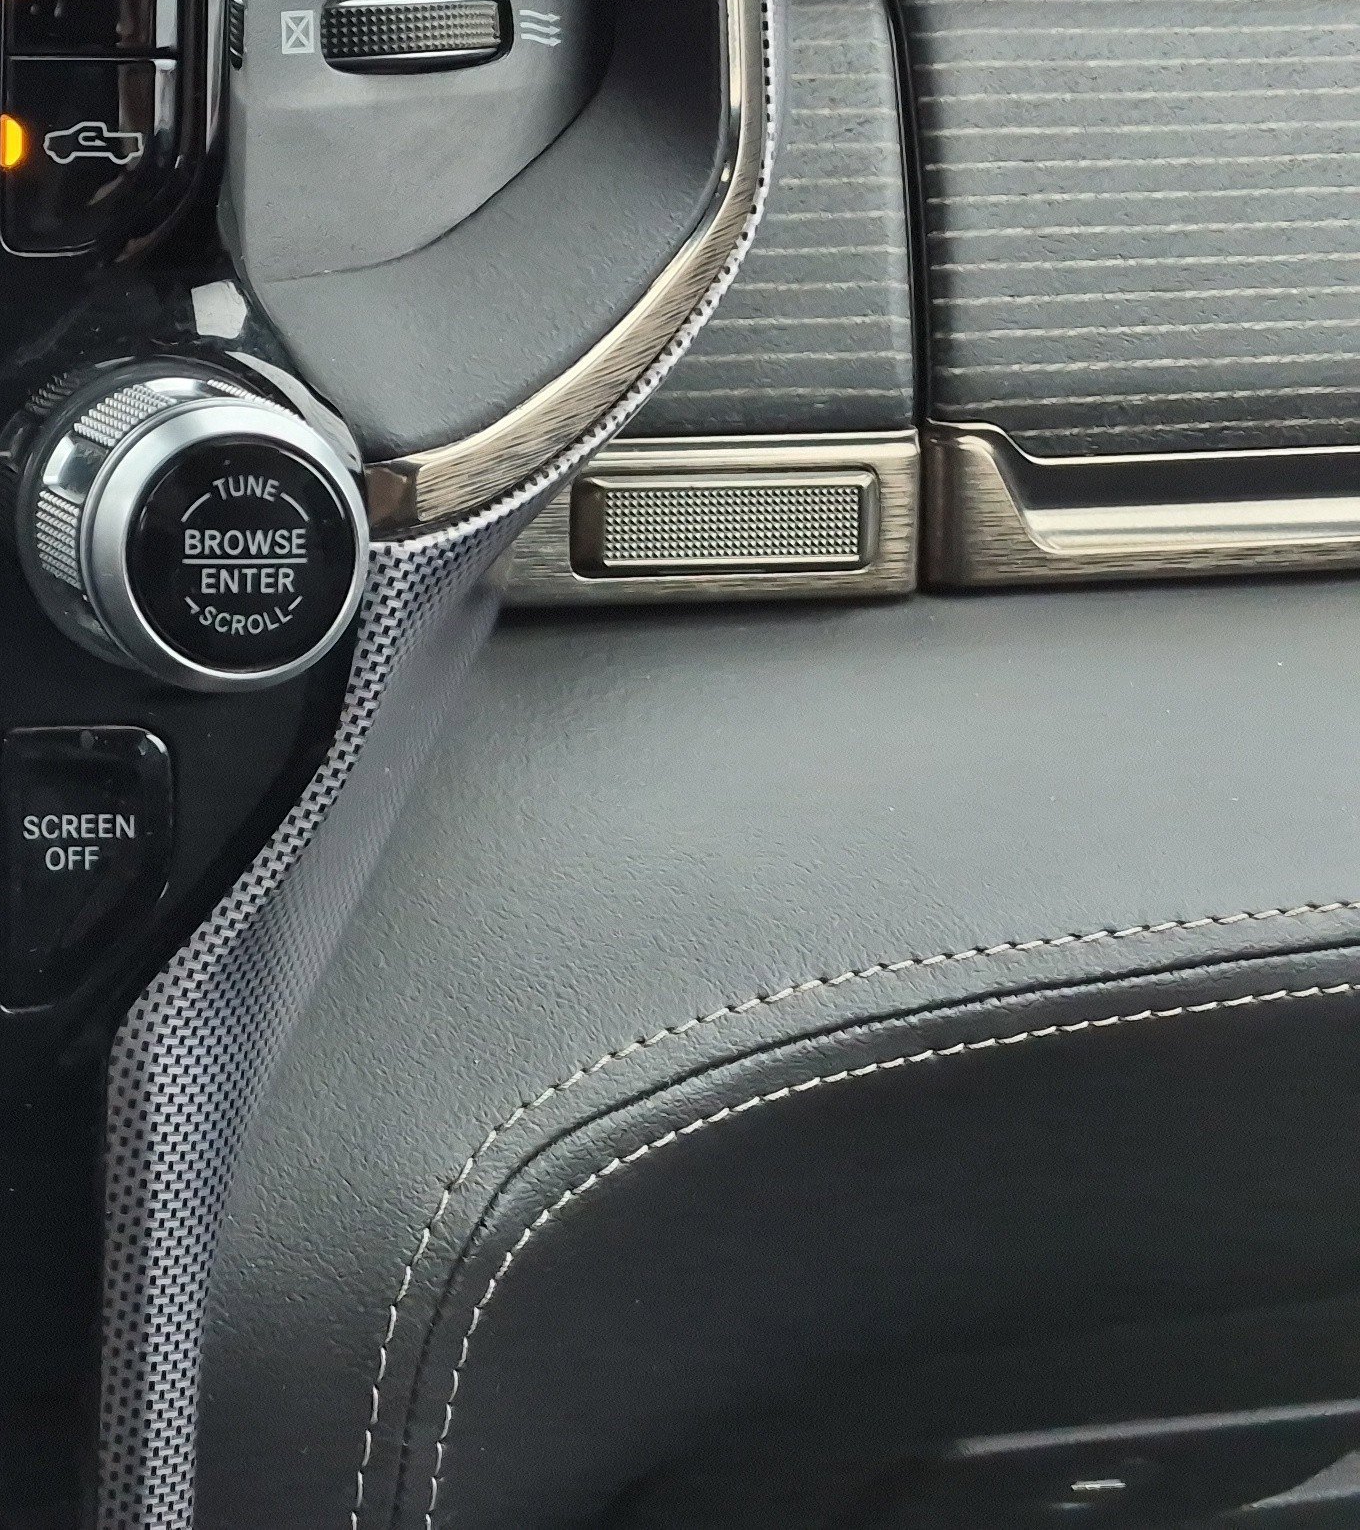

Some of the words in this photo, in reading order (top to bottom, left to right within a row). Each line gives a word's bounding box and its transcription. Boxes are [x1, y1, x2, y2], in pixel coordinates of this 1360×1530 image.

[212, 474, 280, 502] TUNE
[184, 528, 307, 556] BROWSE
[200, 567, 295, 594] ENTER
[198, 605, 294, 636] SCROLL
[22, 813, 135, 840] SCREEN
[45, 847, 100, 871] OFF
